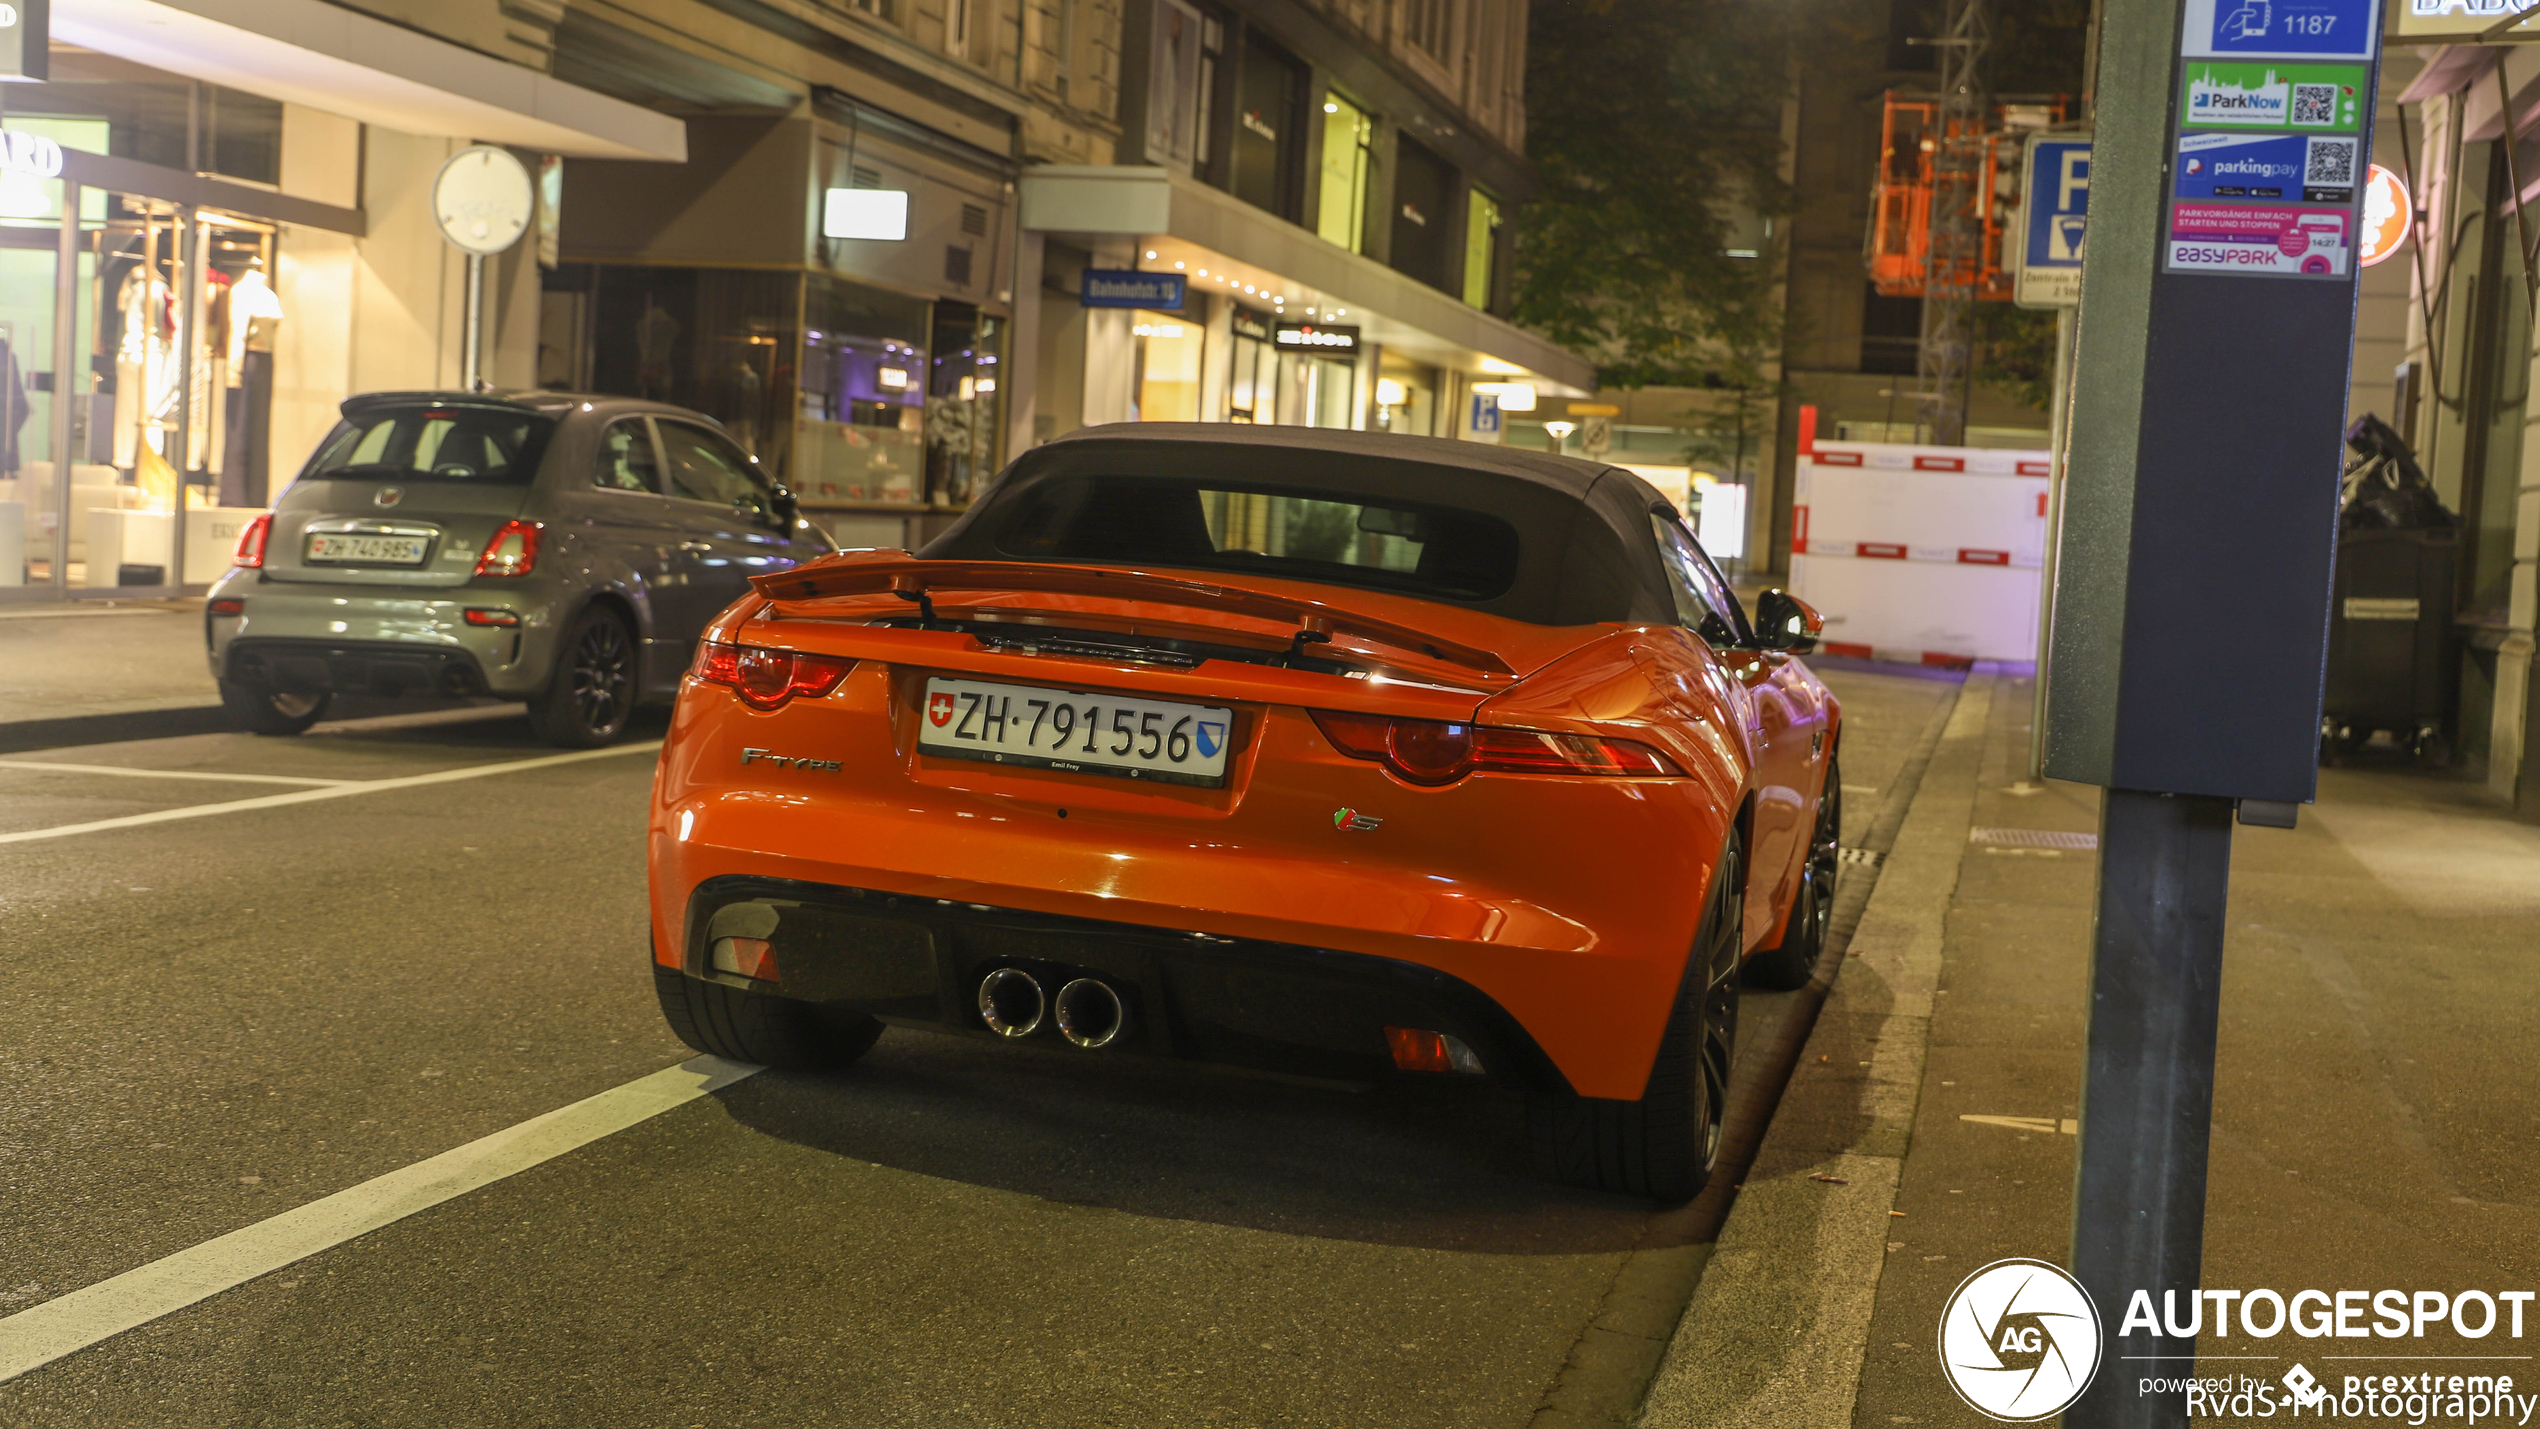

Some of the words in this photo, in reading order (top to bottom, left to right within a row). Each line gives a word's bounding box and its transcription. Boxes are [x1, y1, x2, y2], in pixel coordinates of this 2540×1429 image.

[2284, 14, 2338, 34] 1187
[2212, 93, 2282, 109] ParkNow
[2182, 136, 2228, 148] Schweizweit
[2214, 157, 2299, 178] parkingpay
[2179, 208, 2251, 219] PARKVORGÄNGE
[2254, 210, 2293, 220] EINFACH
[2178, 218, 2217, 227] STARTEN
[2219, 219, 2239, 227] UND
[2240, 220, 2280, 229] STOPPEN
[2312, 239, 2335, 247] 14:27
[1051, 761, 1066, 769] Emil
[1066, 763, 1080, 772] Frey
